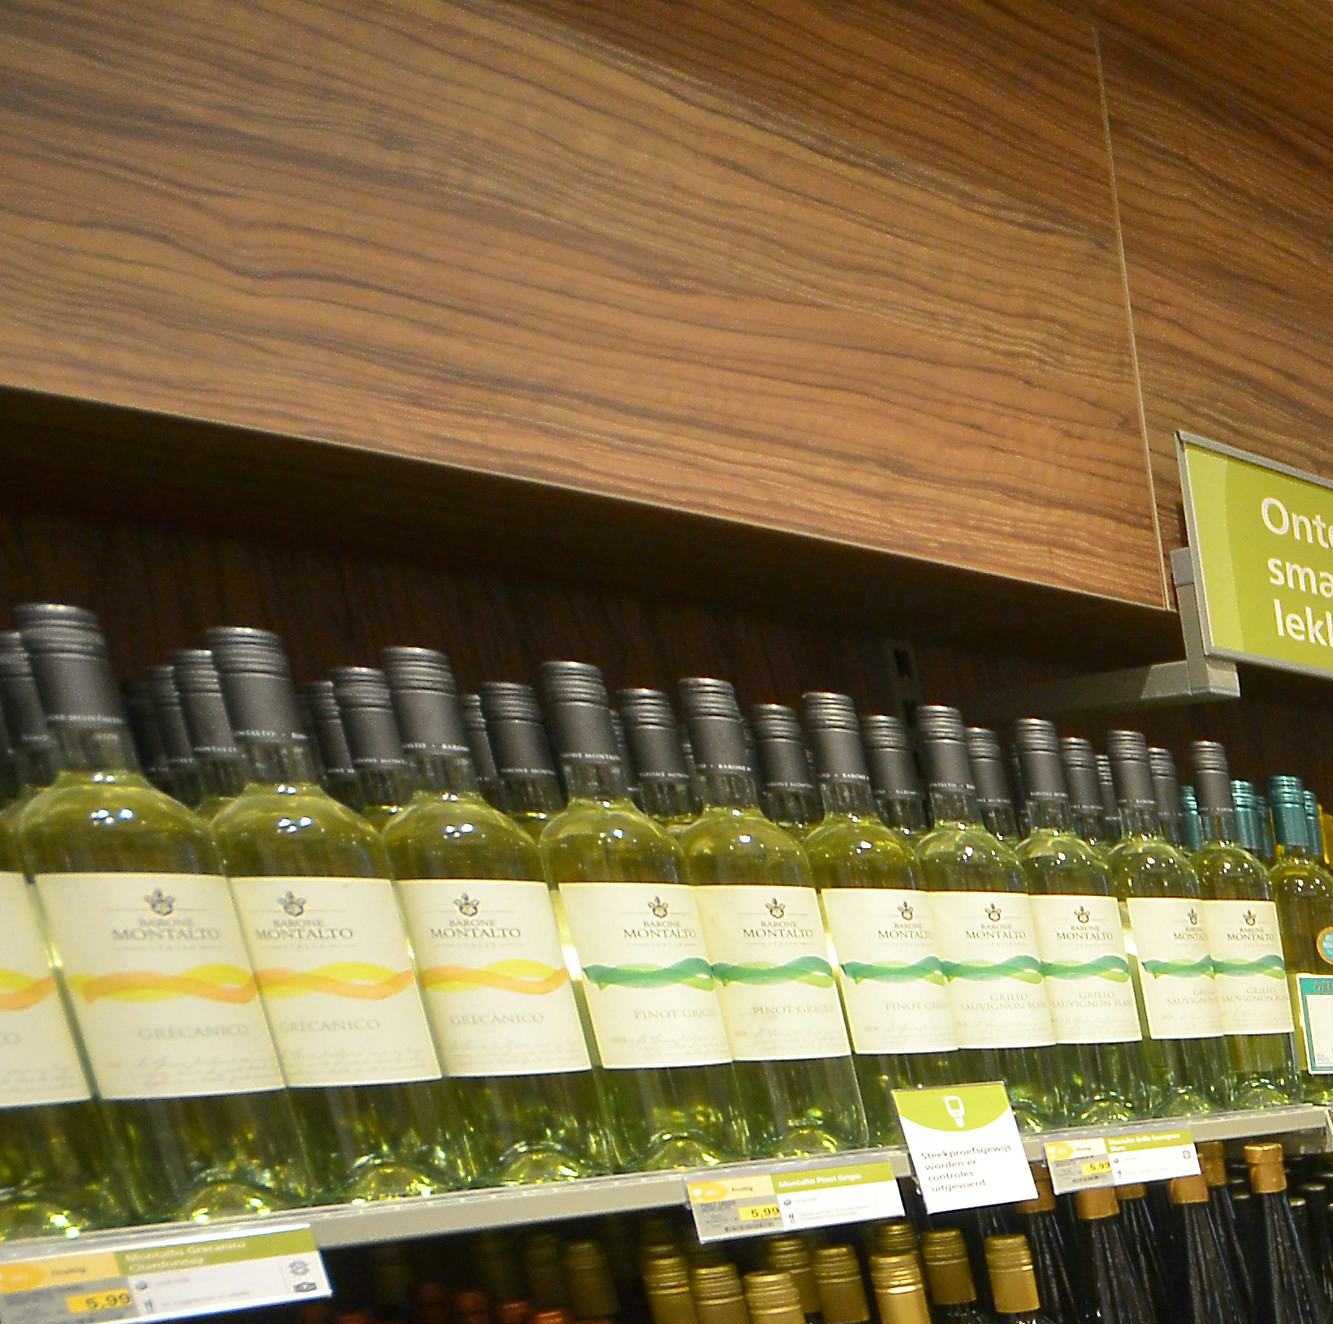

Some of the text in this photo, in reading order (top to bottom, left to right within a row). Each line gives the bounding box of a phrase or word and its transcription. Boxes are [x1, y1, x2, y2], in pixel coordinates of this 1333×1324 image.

[113, 928, 220, 940] MONTALTO
[255, 927, 354, 940] MONTALTO
[431, 928, 521, 938] MONTALTO
[624, 928, 696, 939] MONTALTO
[744, 928, 813, 939] MONTALTO
[966, 931, 1026, 940] MONTALTO
[1057, 932, 1113, 941] MONTALTO
[451, 1013, 544, 1025] GRECANICO
[137, 1024, 249, 1040] GRECANICO
[921, 1144, 1011, 1159] Steekproefsgewijs
[924, 1160, 966, 1171] worden
[928, 1170, 975, 1182] controles
